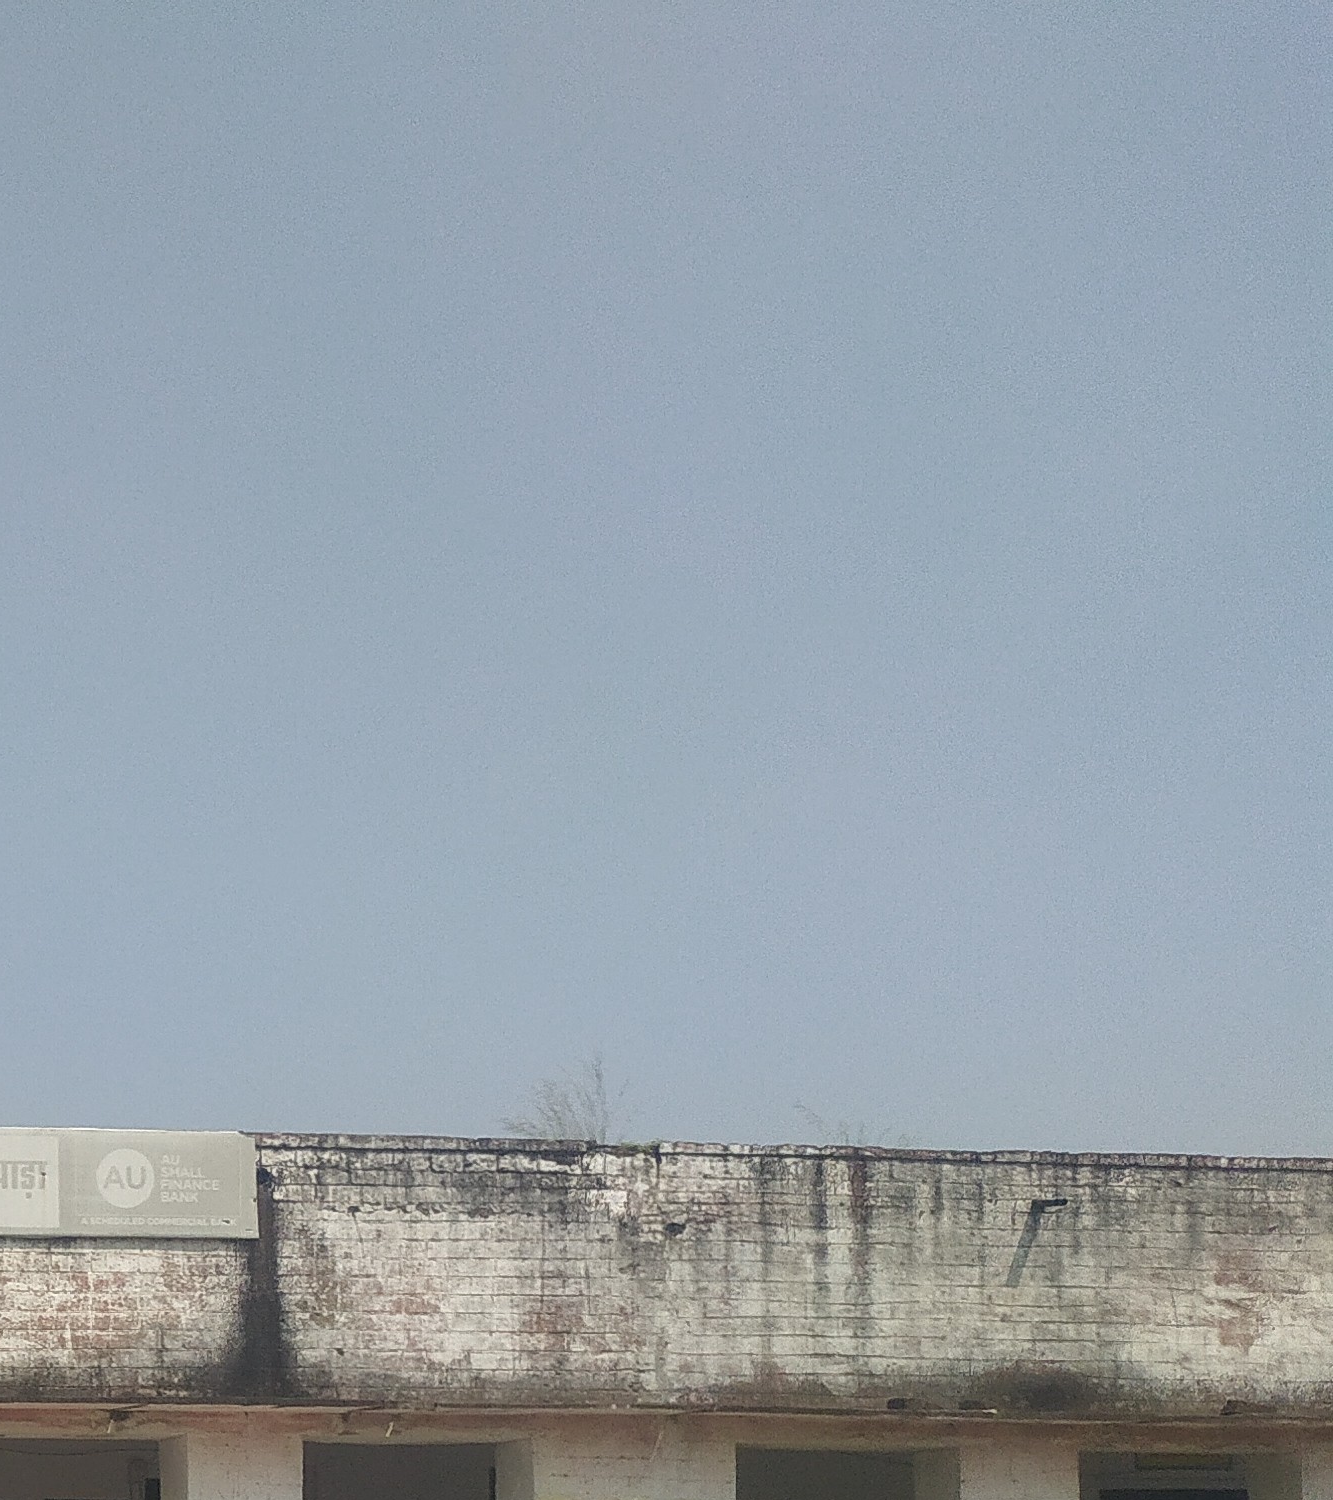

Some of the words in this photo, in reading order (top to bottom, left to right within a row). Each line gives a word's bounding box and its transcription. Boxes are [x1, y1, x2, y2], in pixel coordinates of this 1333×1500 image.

[160, 1154, 182, 1166] AU
[103, 1165, 148, 1190] AU
[160, 1167, 206, 1178] SMALL
[160, 1179, 221, 1191] FINANCE
[160, 1192, 200, 1204] BANK
[81, 1217, 89, 1226] A
[90, 1217, 146, 1226] SCHEDULED
[147, 1217, 209, 1227] COMMERCIAL
